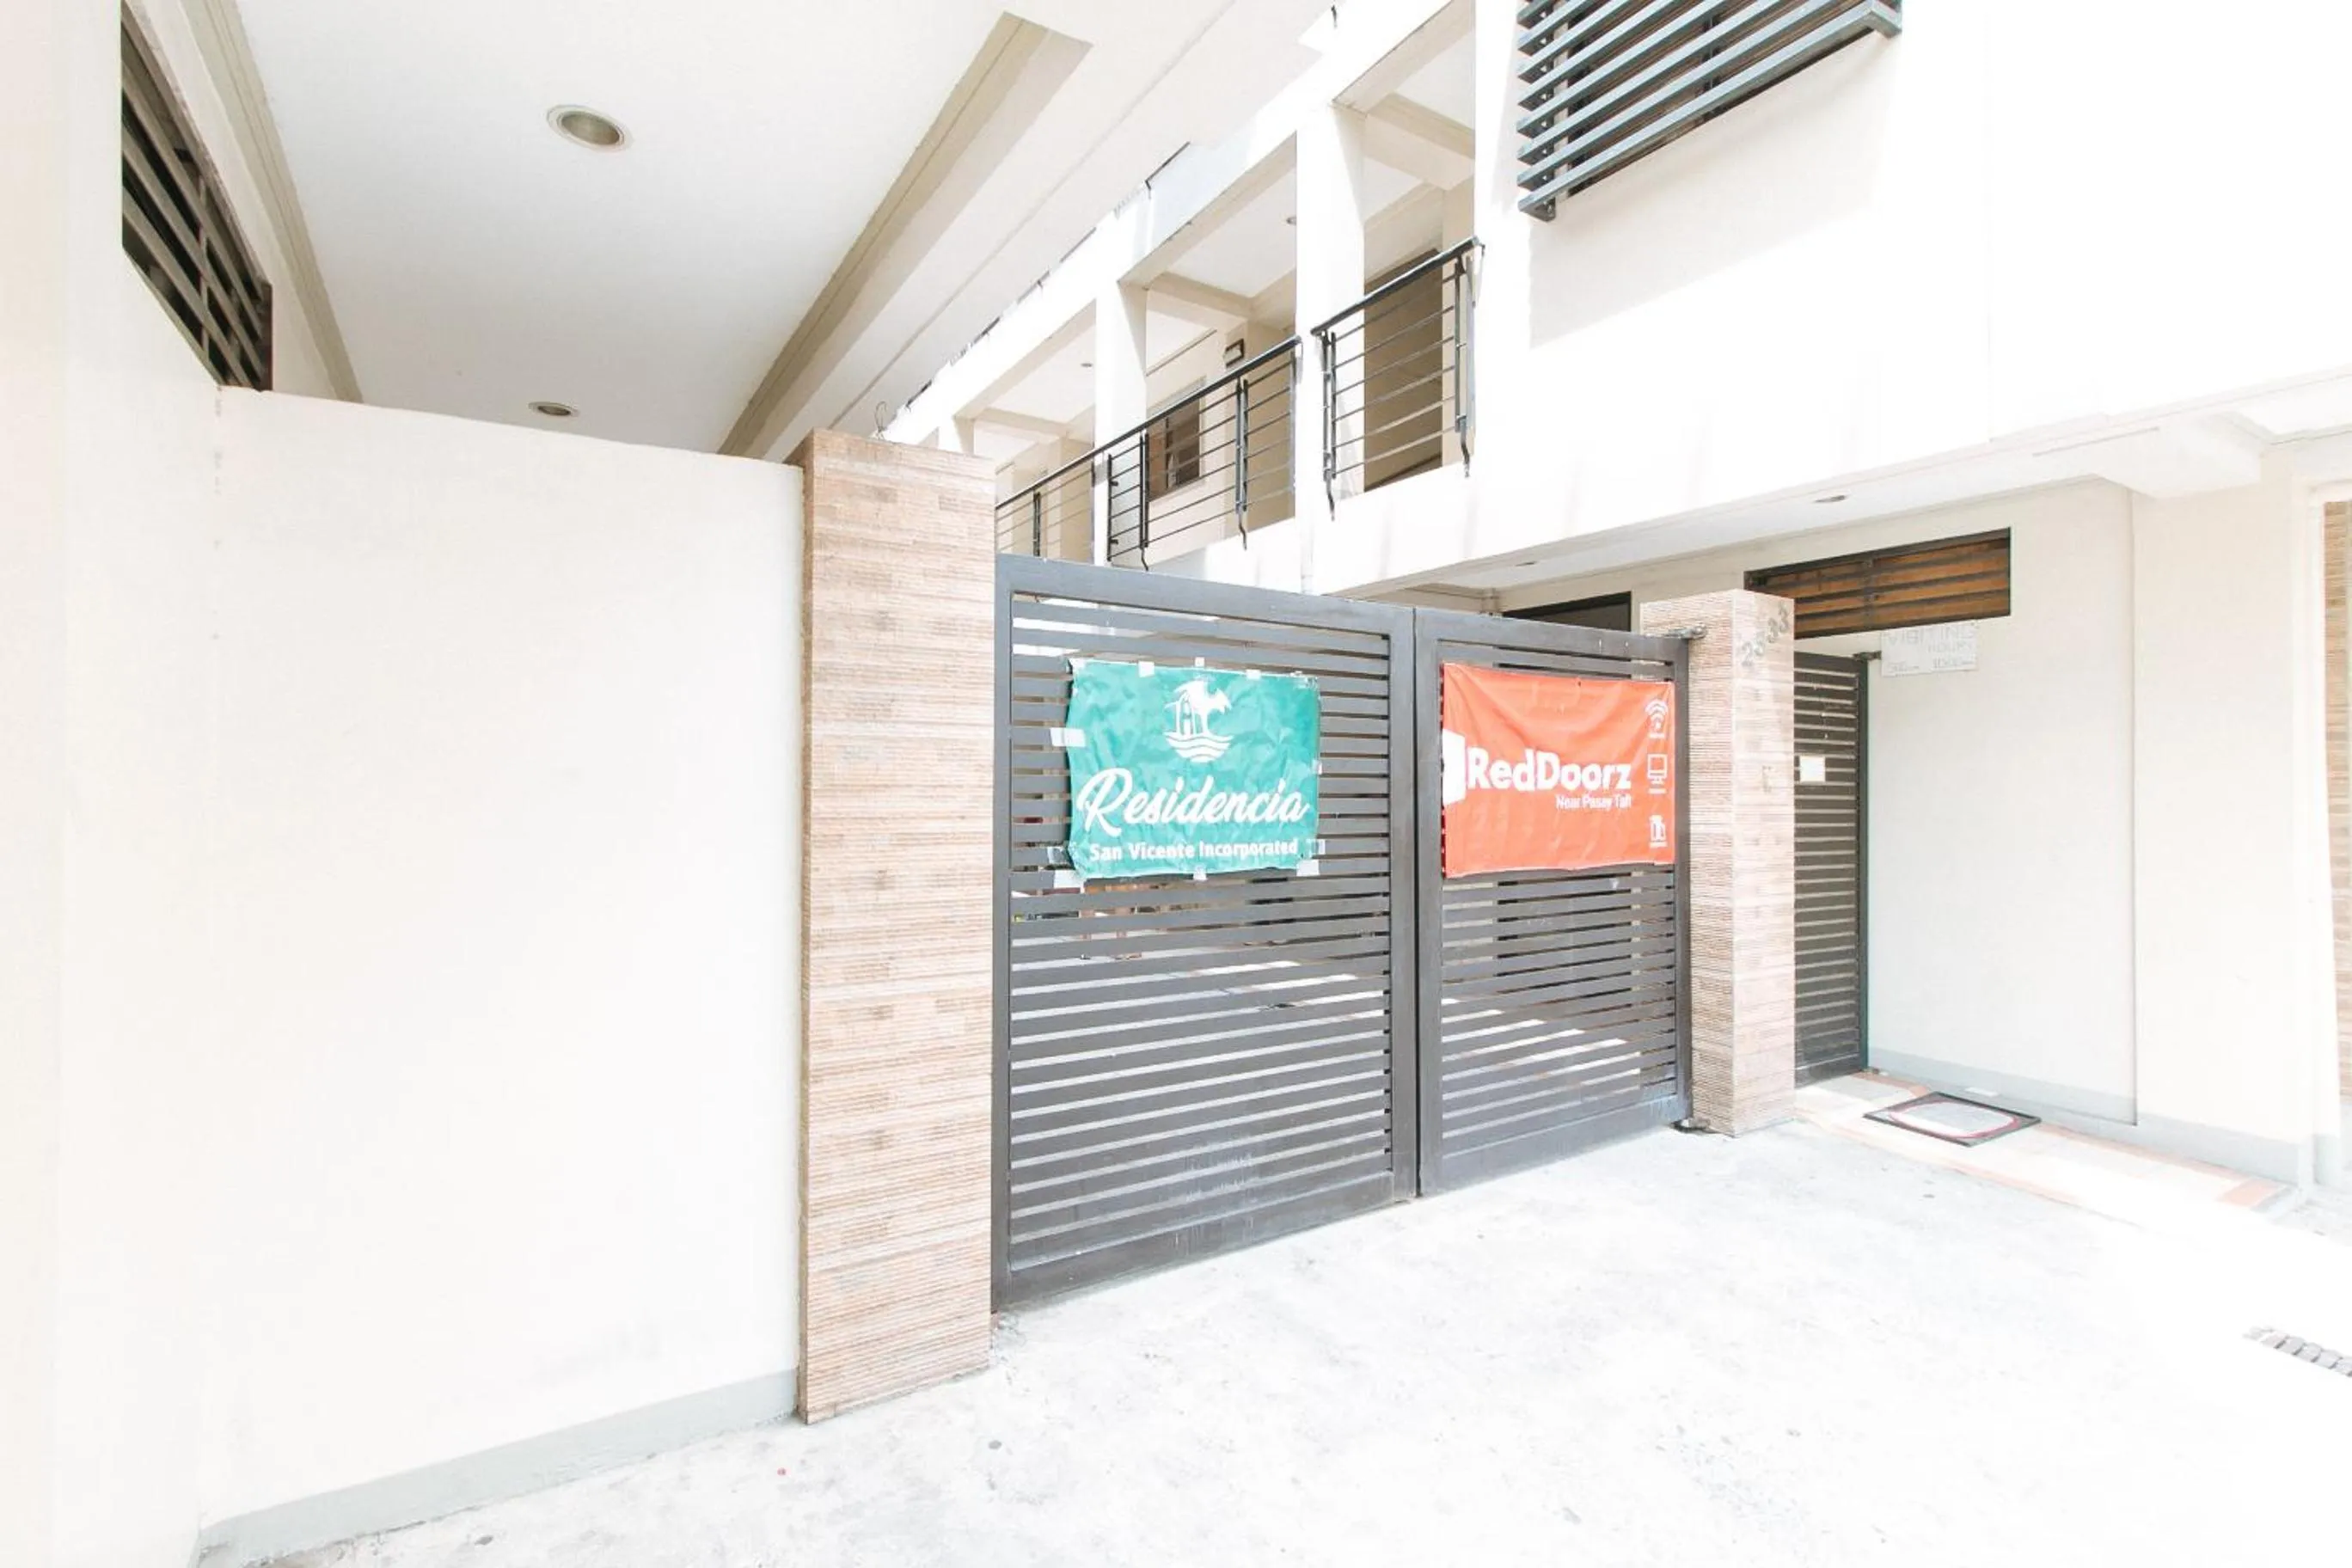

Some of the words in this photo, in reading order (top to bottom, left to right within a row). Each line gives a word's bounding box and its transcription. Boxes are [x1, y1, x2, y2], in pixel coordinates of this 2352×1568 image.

[1467, 746, 1632, 792] RedDoorz
[1076, 768, 1310, 837] Residencia
[1556, 794, 1580, 810] Near
[1582, 794, 1612, 811] Pasay
[1090, 844, 1122, 861] San
[1128, 842, 1194, 859] Vicente
[1199, 838, 1299, 859] Incorporated
